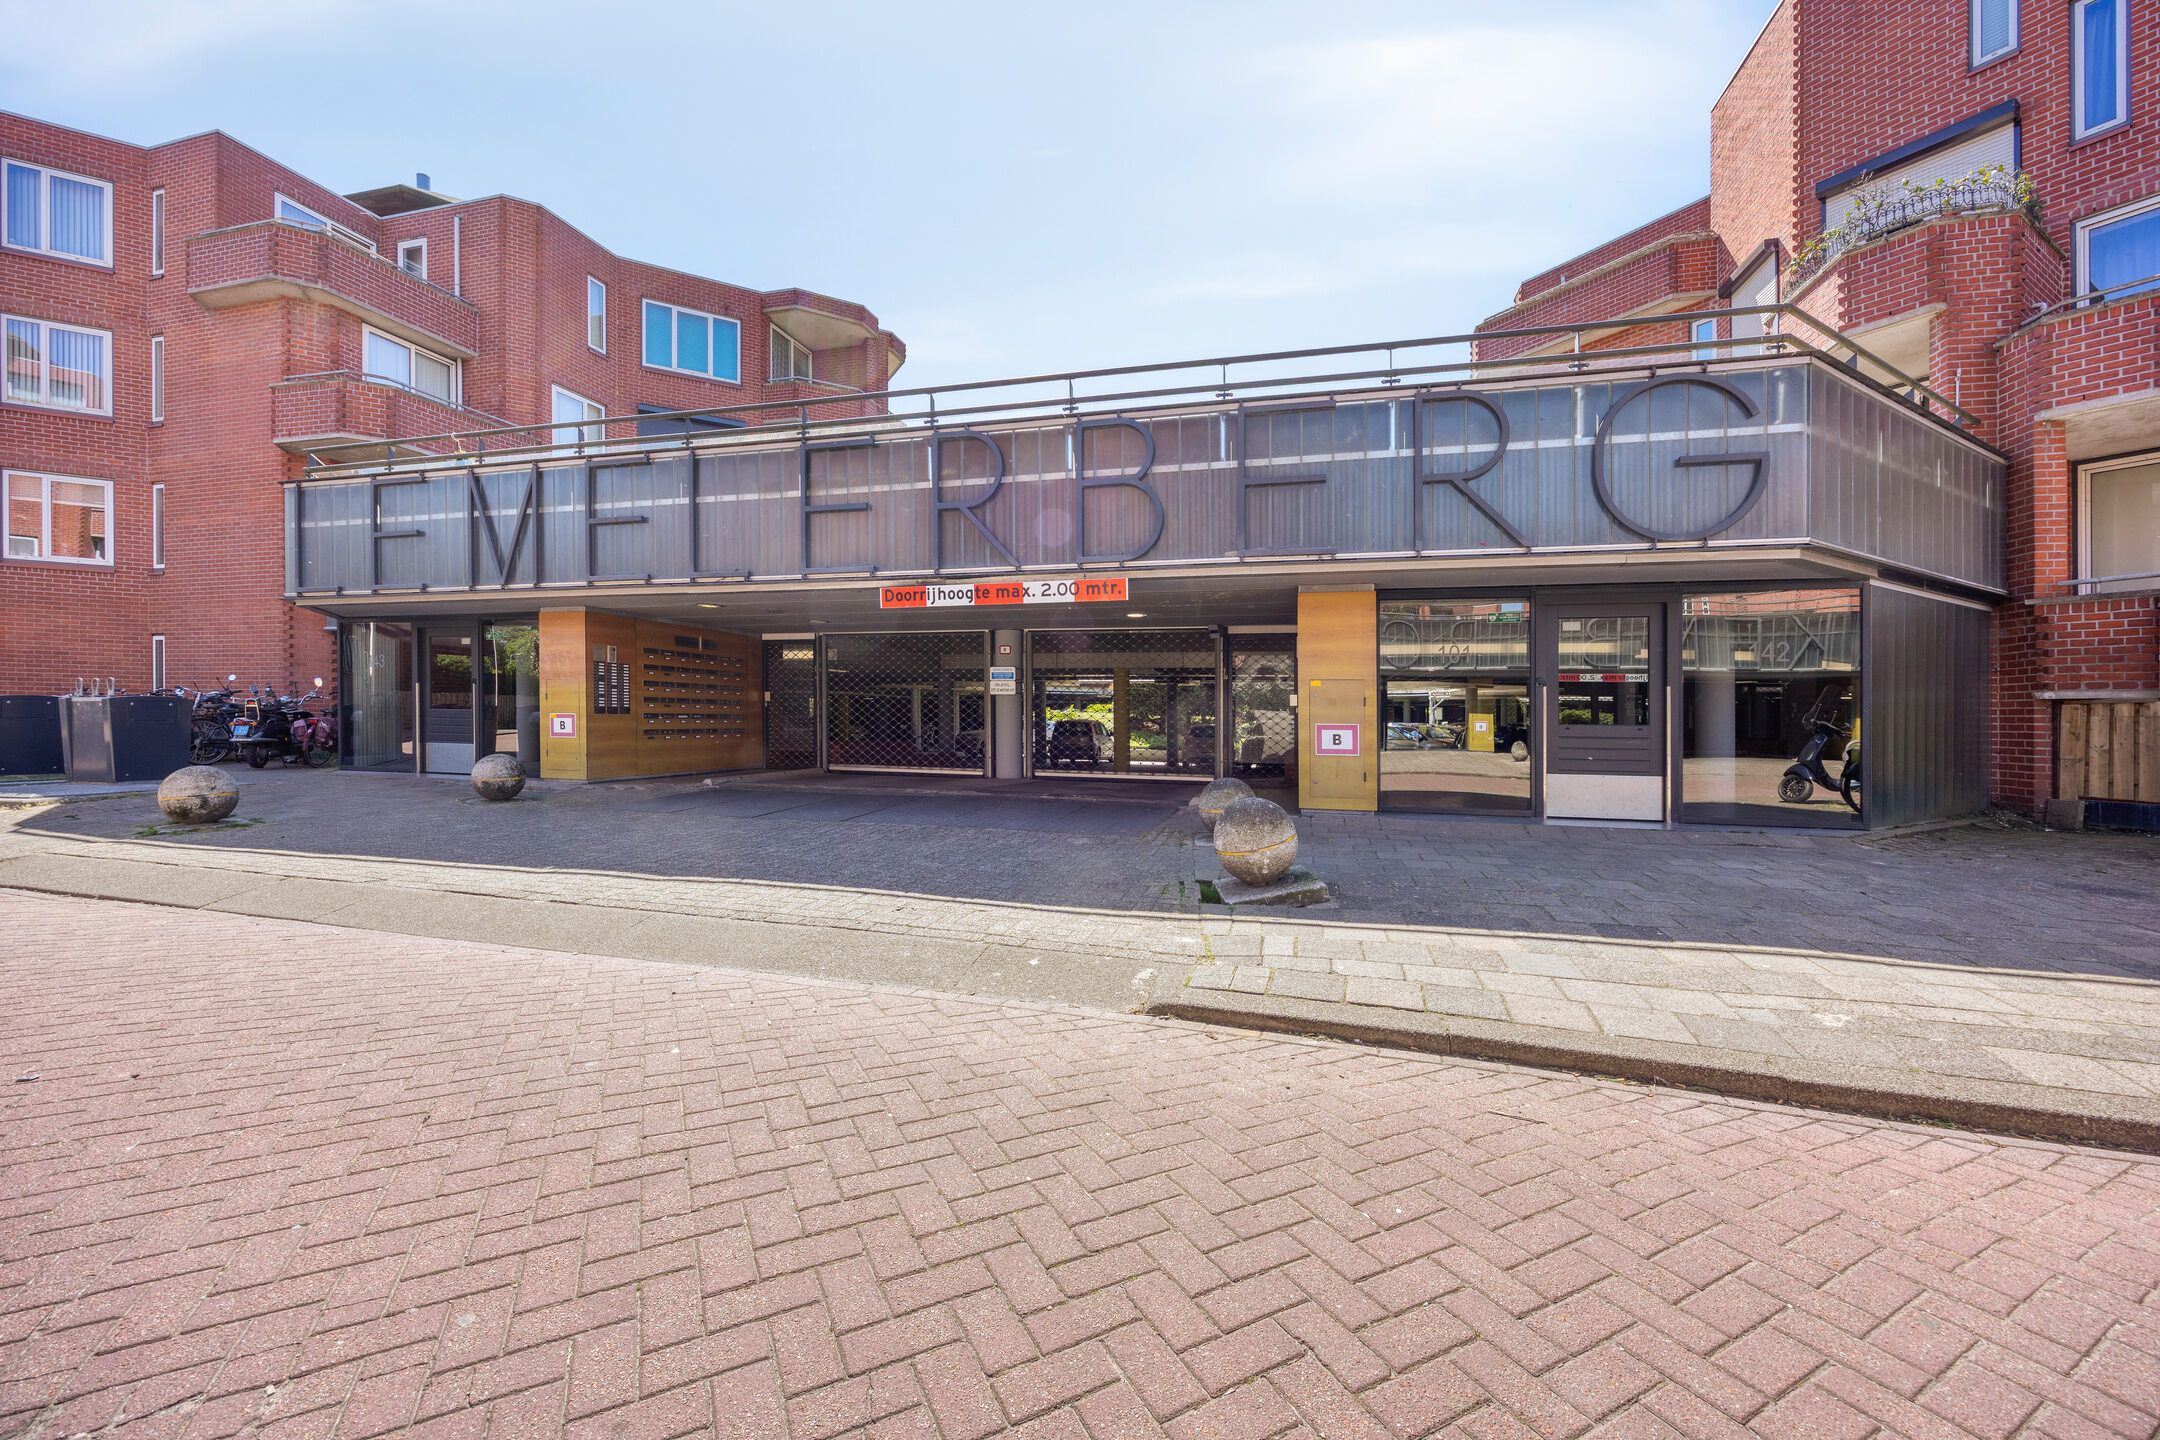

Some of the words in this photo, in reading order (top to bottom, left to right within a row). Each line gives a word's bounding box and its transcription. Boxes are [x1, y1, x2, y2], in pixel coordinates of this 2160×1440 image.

[295, 372, 1770, 595] LEMELERBERG
[884, 585, 990, 605] Doorrijhoogte
[996, 587, 1035, 600] max.
[1041, 582, 1080, 597] 2.00
[1086, 580, 1122, 596] mtr.
[1438, 645, 1470, 663] 101
[1750, 641, 1790, 662] 142
[560, 720, 566, 730] B
[1332, 733, 1342, 746] B
